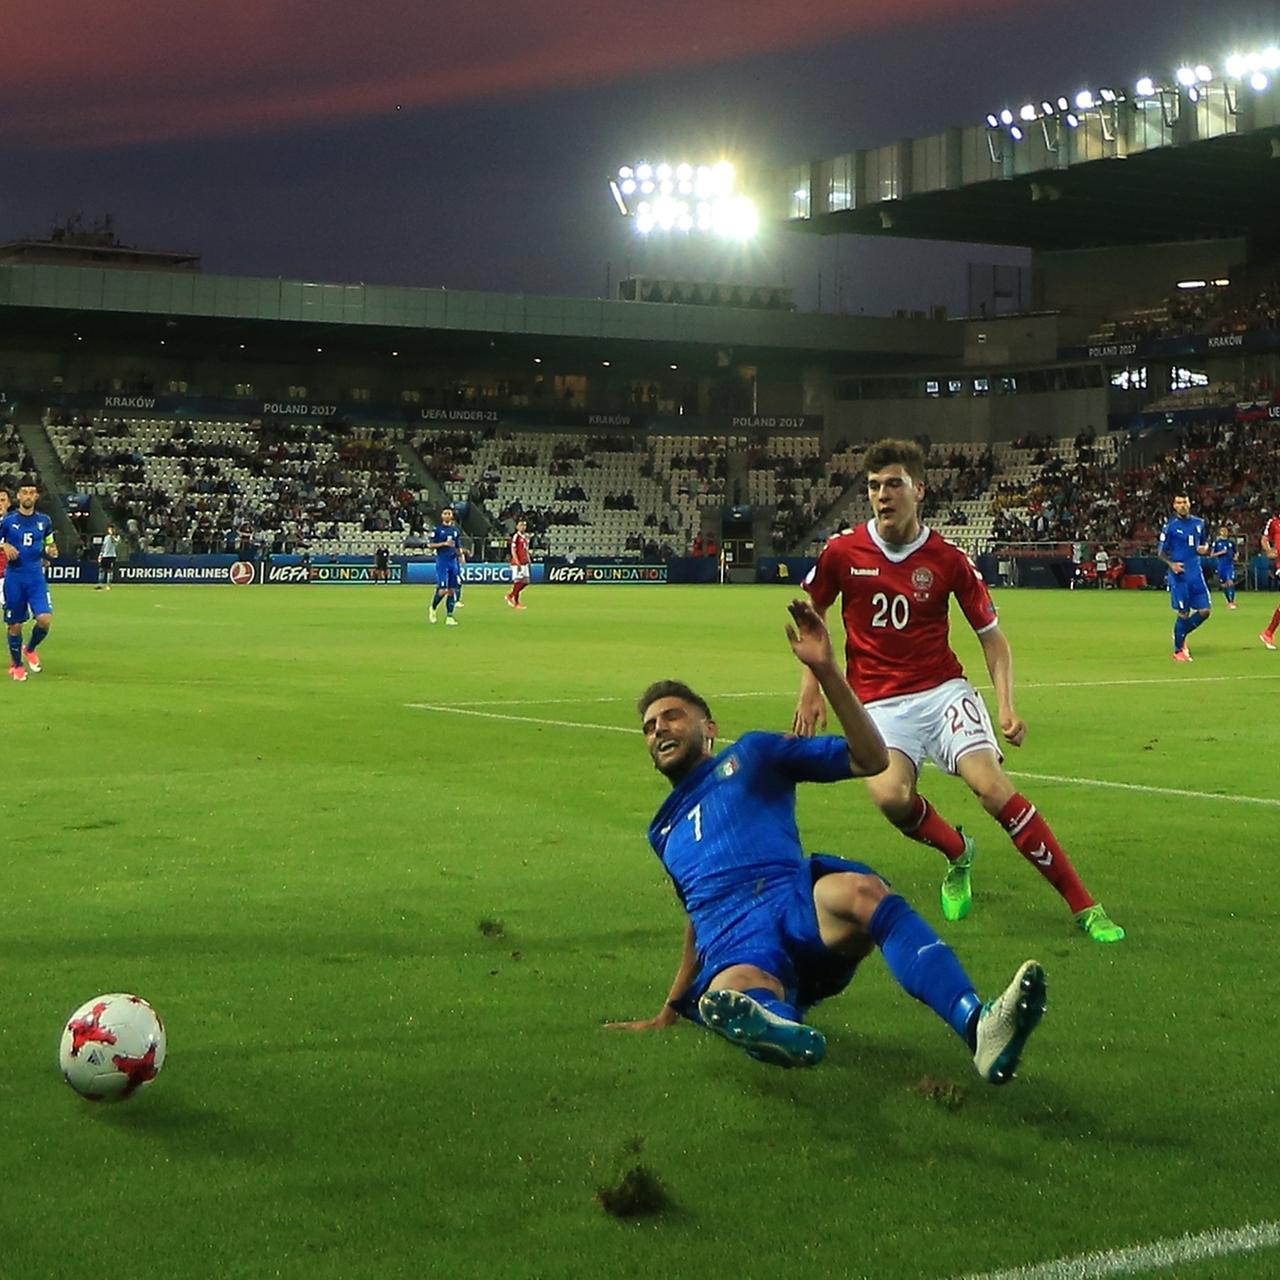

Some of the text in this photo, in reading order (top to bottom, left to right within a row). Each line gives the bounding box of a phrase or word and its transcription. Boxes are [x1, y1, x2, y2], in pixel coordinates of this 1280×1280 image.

[105, 394, 156, 409] KRAKÓW
[263, 402, 338, 417] POLAND 2017
[421, 408, 498, 422] UEFA UNDER-21
[733, 416, 805, 429] POLAND 2017
[23, 532, 33, 547] 15
[119, 568, 229, 579] TURKISH AIRLINES
[269, 565, 310, 581] UEFA
[459, 566, 514, 582] RESPEC
[549, 567, 668, 581] UEFA FOUNDATION
[872, 592, 910, 630] 20
[944, 697, 981, 735] 20
[687, 803, 702, 842] 7
